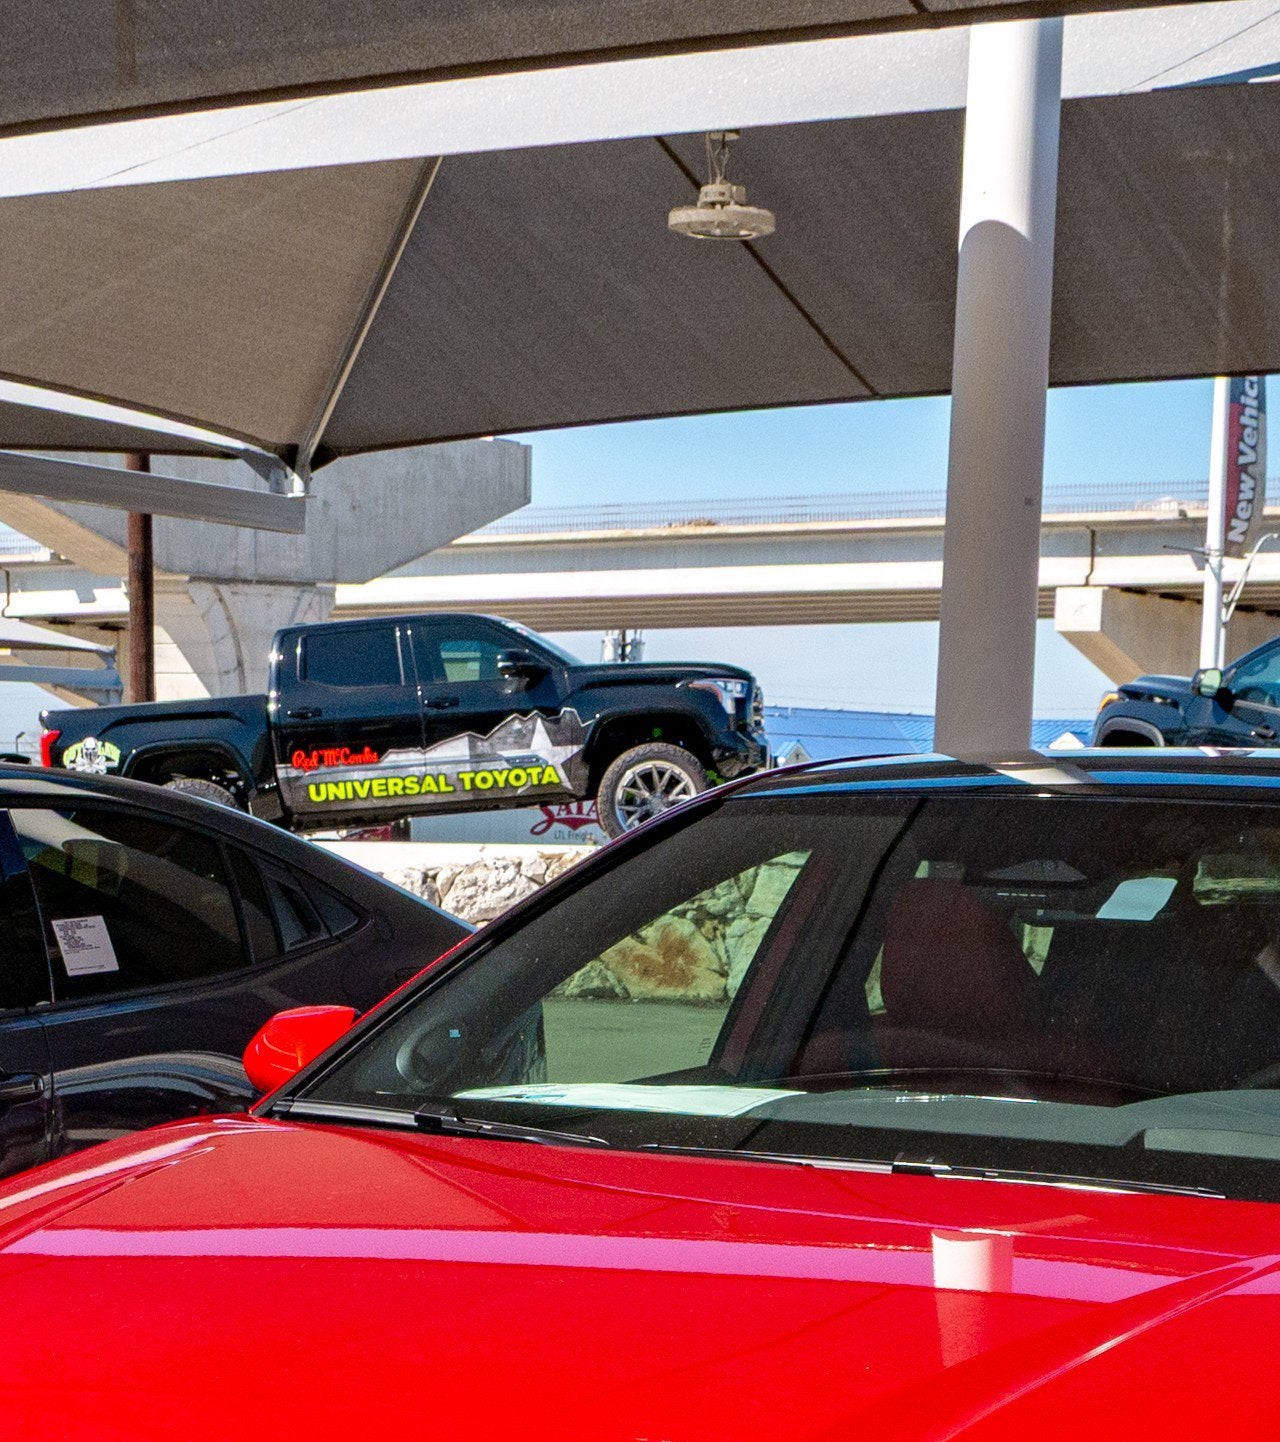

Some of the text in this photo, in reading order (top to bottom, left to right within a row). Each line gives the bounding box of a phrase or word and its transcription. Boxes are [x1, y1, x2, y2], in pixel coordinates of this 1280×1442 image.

[1228, 472, 1255, 544] New
[291, 750, 319, 772] Red
[308, 766, 560, 802] UNIVERSAL TOYOTA
